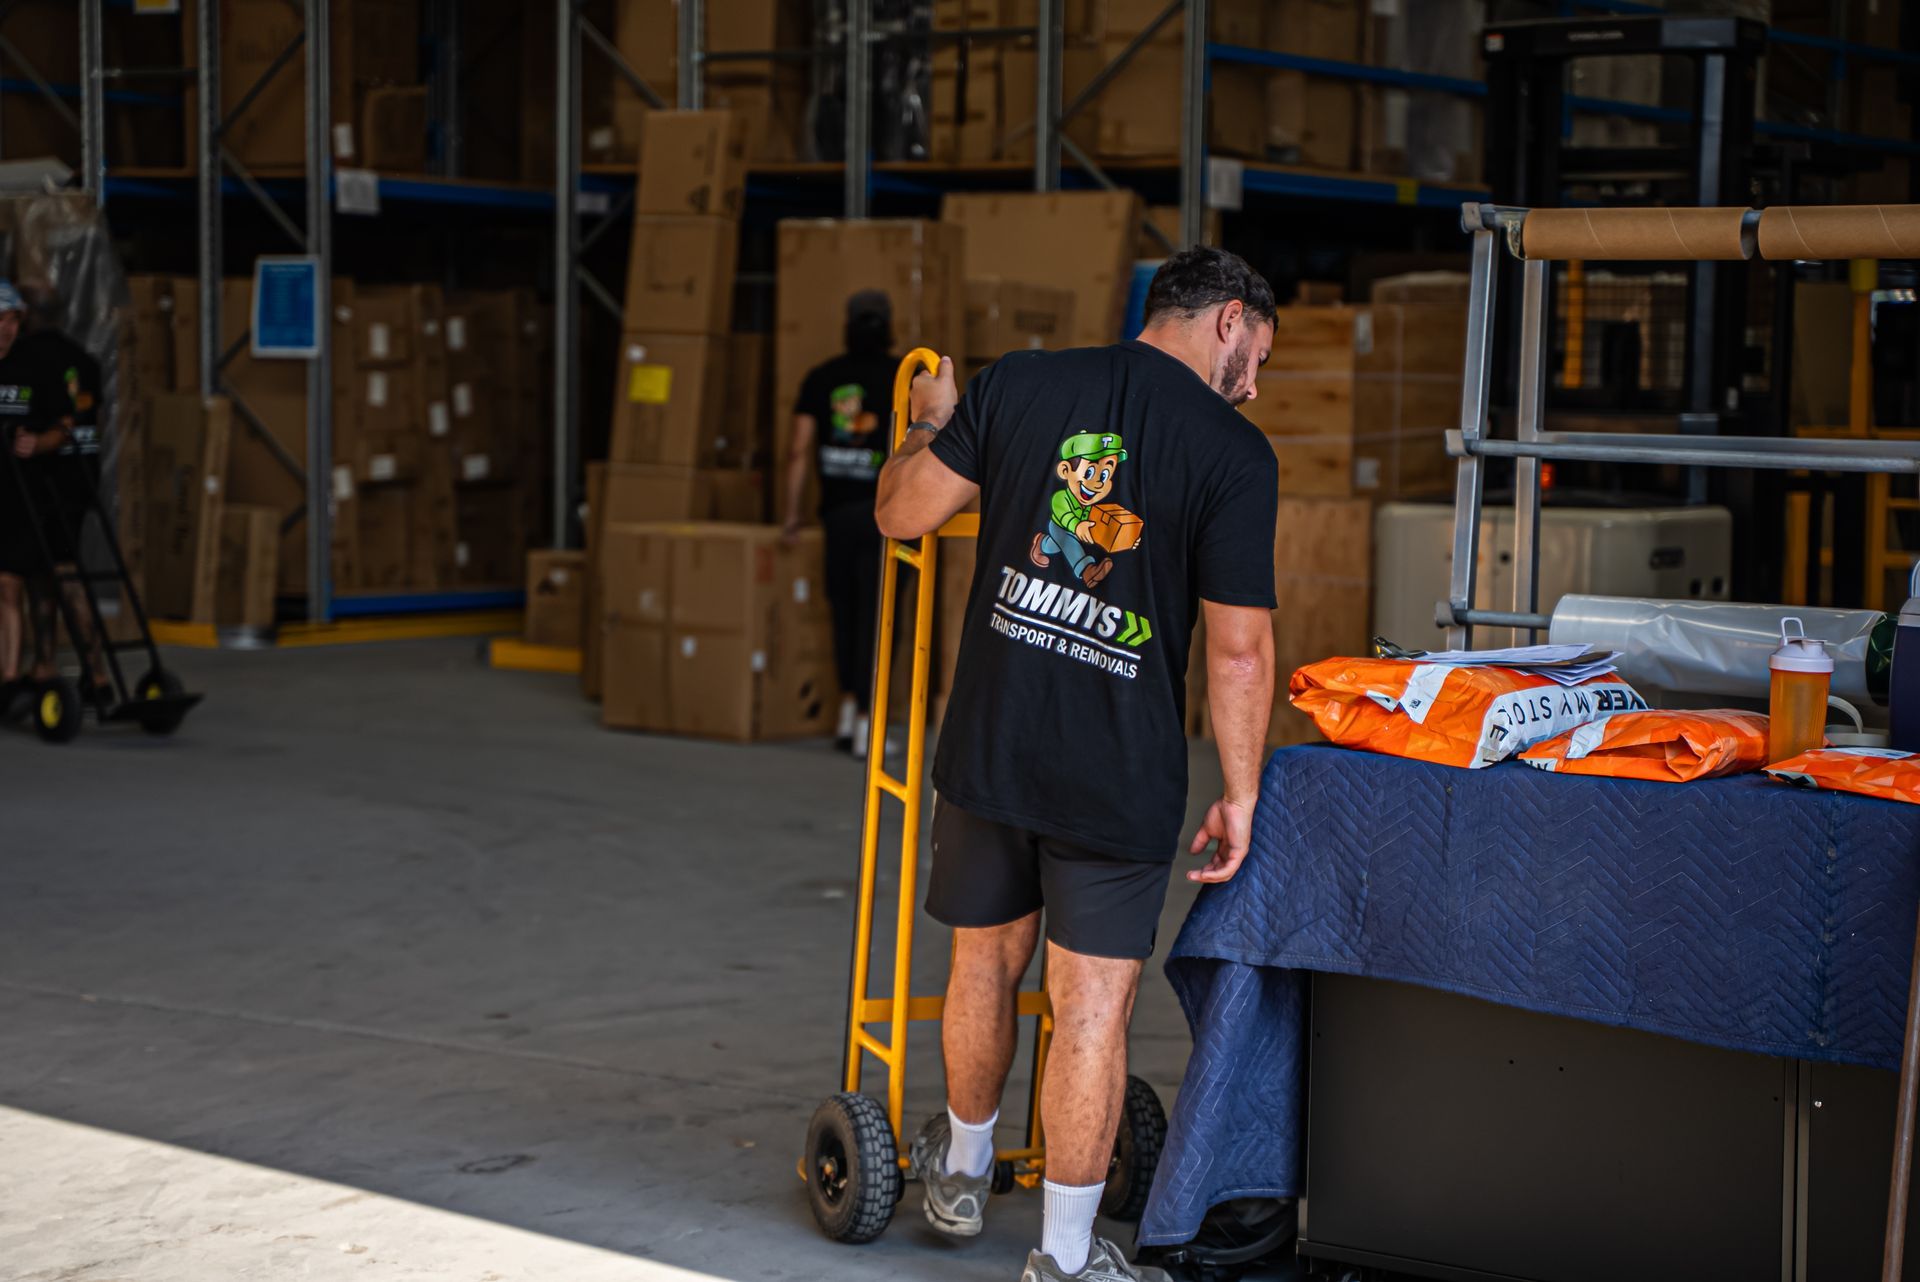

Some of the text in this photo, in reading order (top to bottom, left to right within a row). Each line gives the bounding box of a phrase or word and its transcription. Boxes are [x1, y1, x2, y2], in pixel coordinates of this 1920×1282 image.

[1101, 436, 1113, 448] T
[997, 565, 1122, 639] TOMMYS
[990, 612, 1138, 679] TRANSPORT & REMOVALS
[1561, 692, 1590, 716] MY
